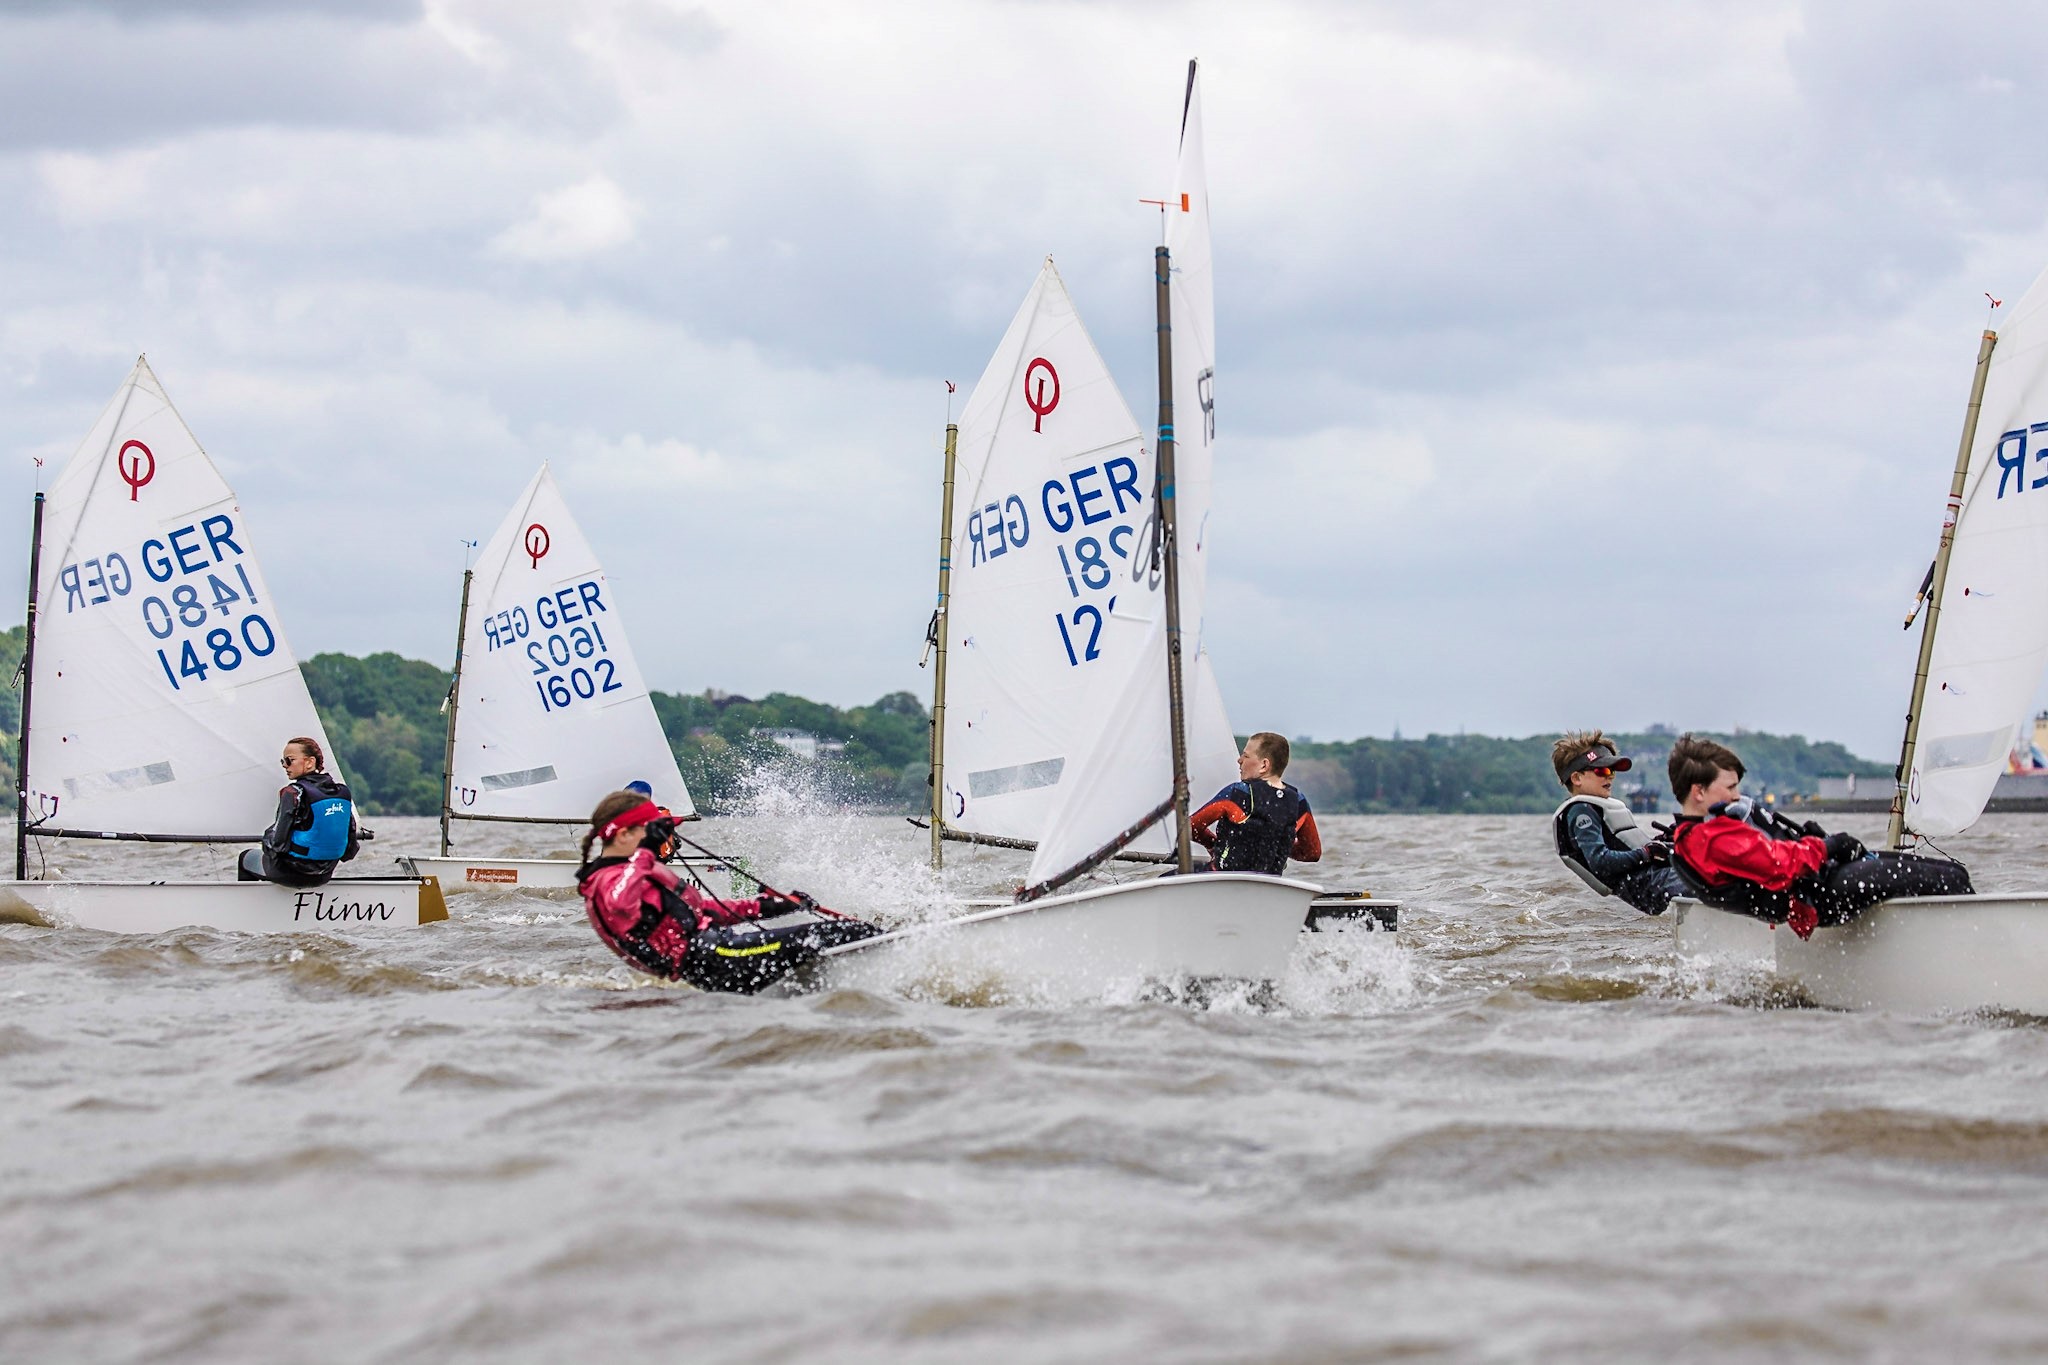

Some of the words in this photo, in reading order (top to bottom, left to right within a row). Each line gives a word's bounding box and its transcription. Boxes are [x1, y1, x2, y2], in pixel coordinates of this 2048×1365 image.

[1042, 456, 1142, 533] GER
[141, 514, 244, 582] GER
[537, 581, 607, 629] GER
[157, 614, 275, 690] 1480
[536, 659, 623, 712] 1602
[294, 892, 395, 921] Flinn
